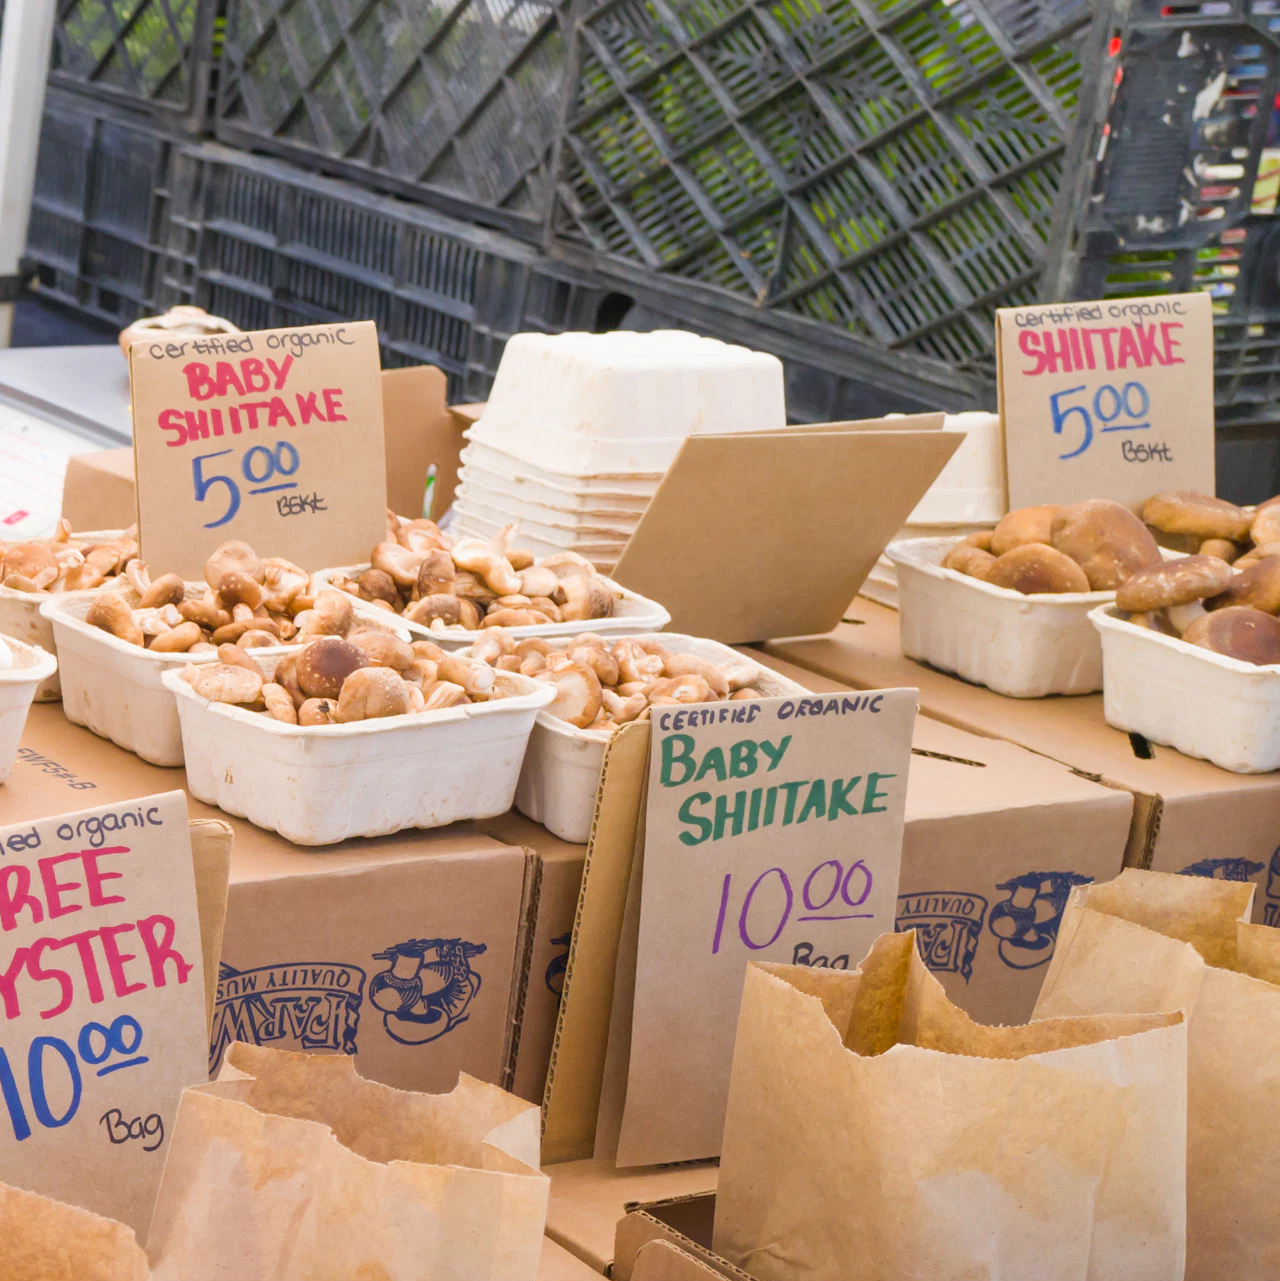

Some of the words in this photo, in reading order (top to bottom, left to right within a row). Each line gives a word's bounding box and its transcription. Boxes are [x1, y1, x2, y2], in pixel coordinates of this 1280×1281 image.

[1014, 305, 1103, 328] certified
[1108, 300, 1187, 327] organic
[149, 336, 254, 360] certified
[266, 328, 356, 358] organic
[1018, 322, 1185, 377] SHIITAKE
[182, 354, 294, 401] BABY
[158, 388, 348, 447] SHIITAKE
[660, 703, 761, 731] CERTIFIED
[777, 694, 884, 720] ORGANIC
[659, 733, 792, 788] BABY
[56, 806, 163, 847] organic
[678, 771, 898, 846] SHIITAKE
[901, 898, 975, 916] QUALITY
[266, 969, 351, 988] QUALITY
[99, 1108, 165, 1152] Bag
